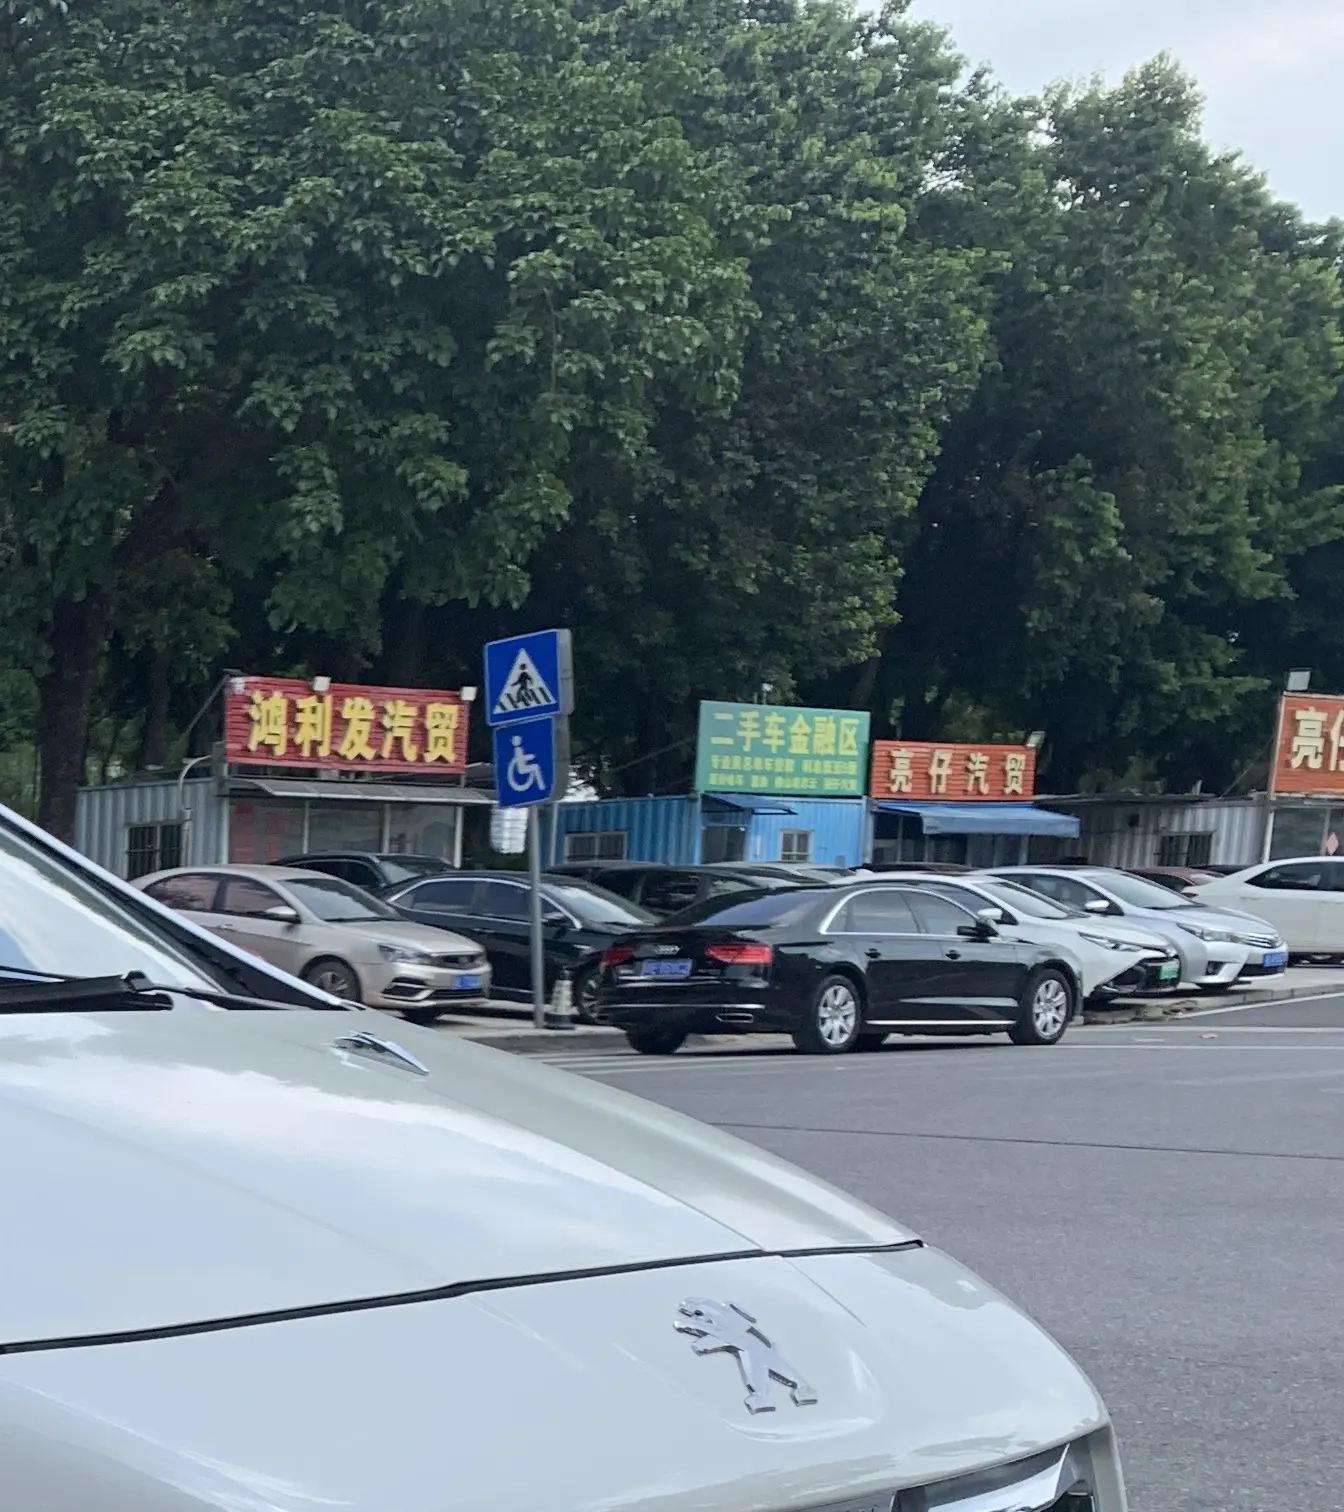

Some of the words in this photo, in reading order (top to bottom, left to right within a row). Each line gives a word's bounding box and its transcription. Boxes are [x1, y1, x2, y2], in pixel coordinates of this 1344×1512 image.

[247, 690, 459, 764] 鸿利发汽贸
[711, 711, 861, 756] 二手车金融区
[890, 748, 1027, 795] 亮仔汽贸
